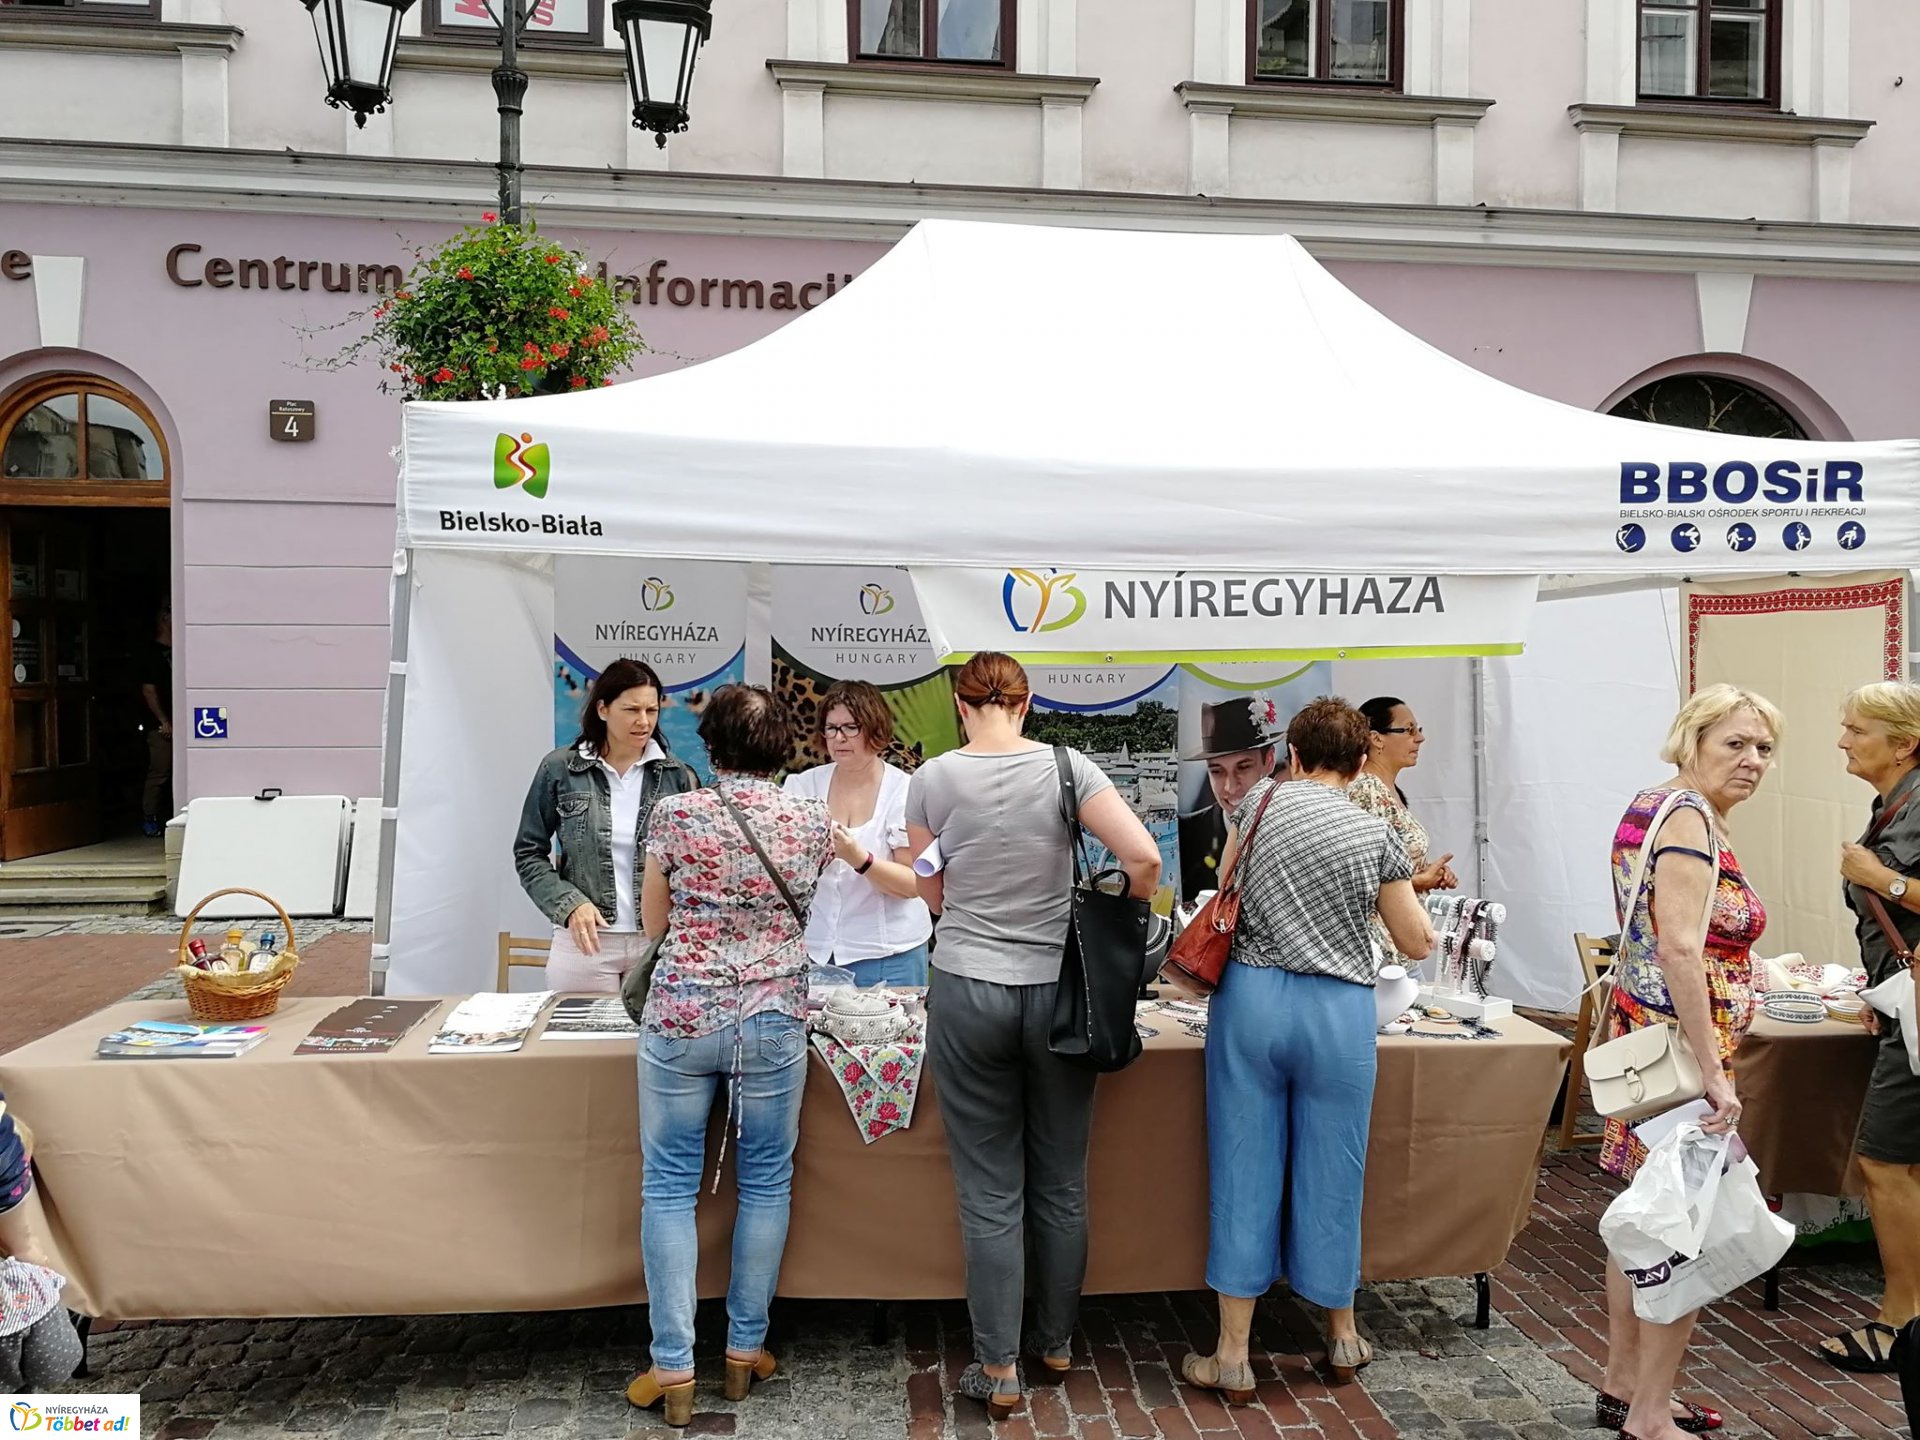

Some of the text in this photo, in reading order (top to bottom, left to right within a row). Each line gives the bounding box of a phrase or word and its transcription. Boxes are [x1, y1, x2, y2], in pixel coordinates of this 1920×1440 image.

[166, 243, 853, 310] Centrum Informaci
[284, 416, 299, 437] 4
[1619, 460, 1864, 504] BBOSiR
[439, 510, 603, 536] Bielsko-Biała
[1619, 509, 1706, 518] BIELSKO-BIALSKI
[1707, 507, 1759, 518] OŚRODEK
[1761, 508, 1803, 518] SPORTU
[1810, 507, 1867, 517] REKREACJI
[595, 620, 720, 642] NYÍREGYHÁZA
[811, 623, 931, 643] NYÍREGYHÁZ
[836, 653, 918, 664] HUNGARY
[1048, 673, 1126, 684] HUNGARY
